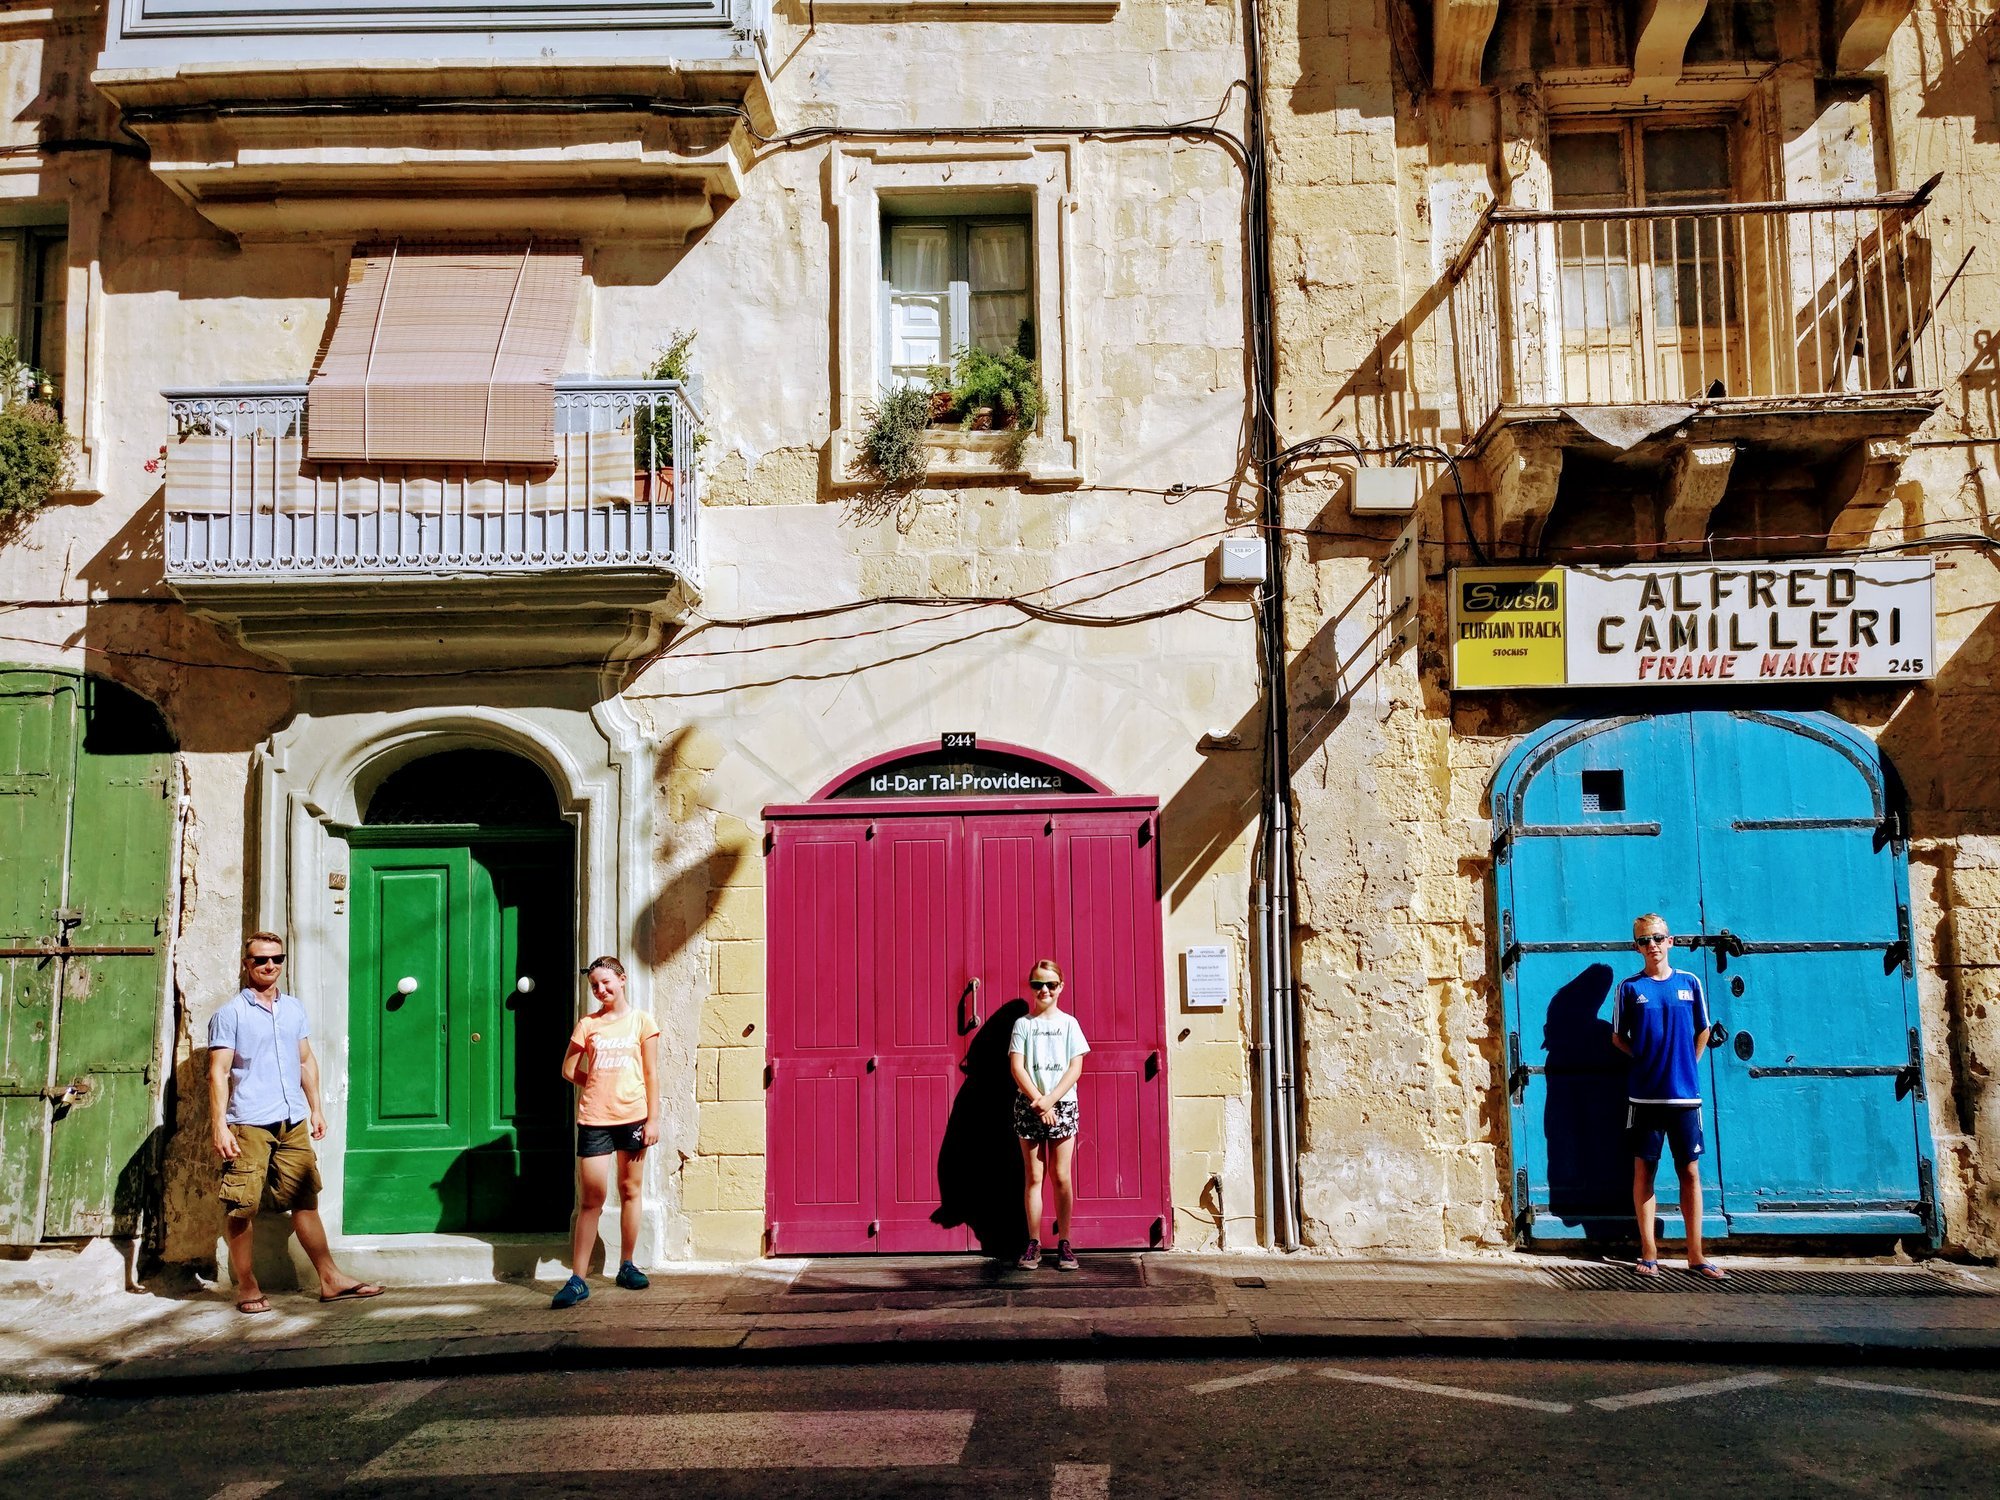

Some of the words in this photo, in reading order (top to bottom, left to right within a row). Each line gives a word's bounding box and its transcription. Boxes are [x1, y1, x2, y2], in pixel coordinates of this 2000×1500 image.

[1465, 584, 1554, 610] Swish
[1638, 567, 1857, 611] ALFRED
[1460, 621, 1515, 640] CURTAIN
[1517, 621, 1562, 639] TRACK
[1597, 607, 1901, 654] CAMILLERI
[1492, 647, 1529, 657] STOCKIST
[1638, 654, 1738, 680] FRAME
[1759, 651, 1860, 677] MAKER
[1888, 658, 1924, 674] 245
[870, 774, 927, 792] Id-Dar
[929, 772, 1062, 791] Tal-Providenza
